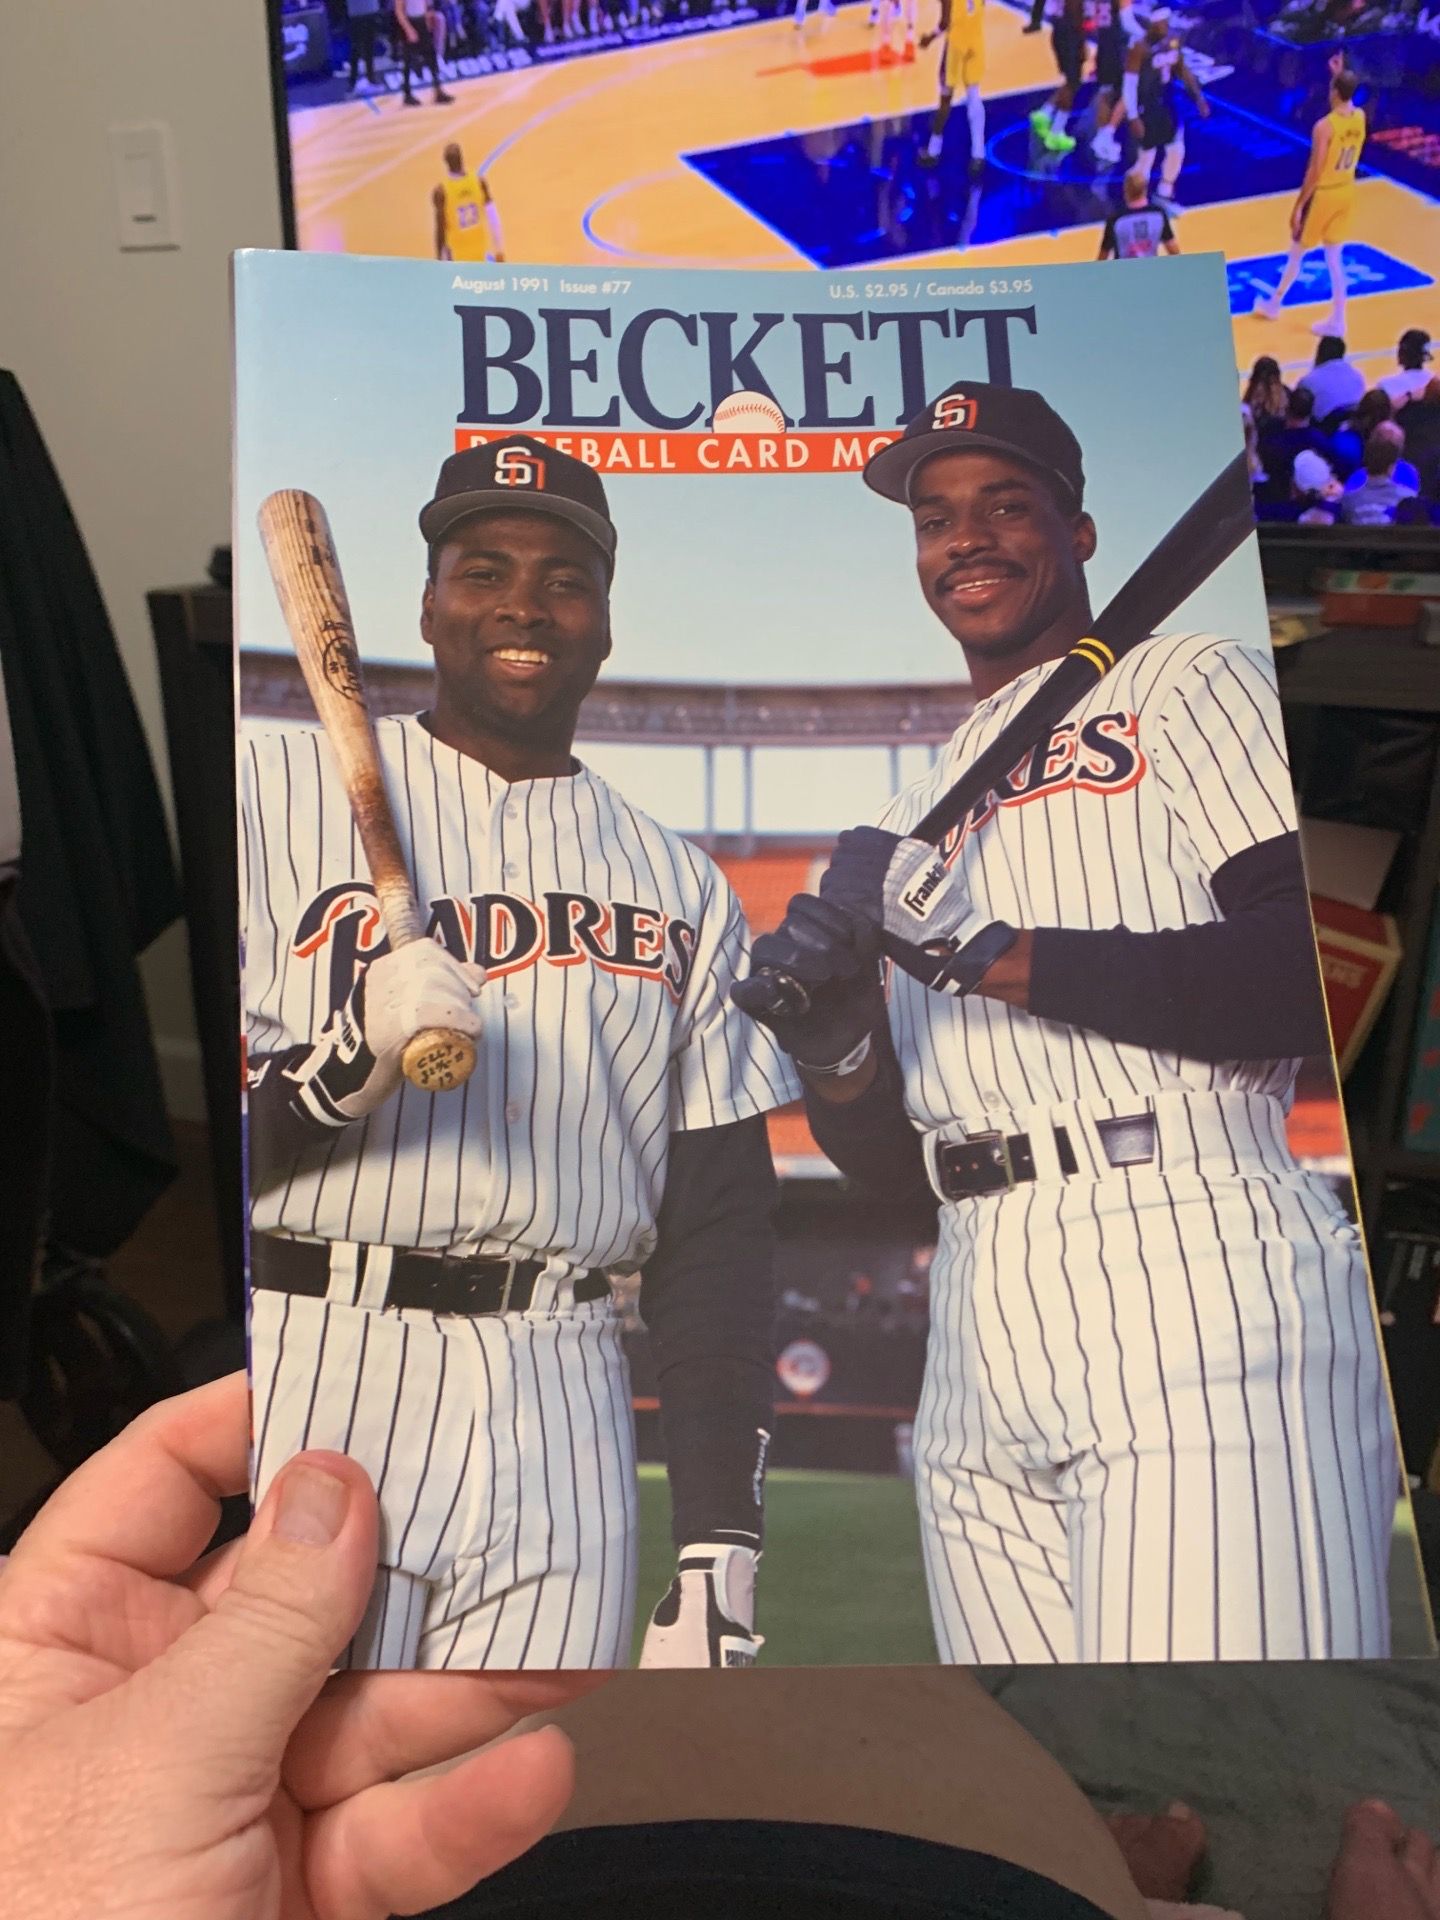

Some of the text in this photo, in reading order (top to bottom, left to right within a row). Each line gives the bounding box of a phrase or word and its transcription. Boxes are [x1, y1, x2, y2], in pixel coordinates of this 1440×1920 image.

[452, 276, 631, 294] August 1991 Issue #77
[829, 284, 860, 299] U.S.
[865, 283, 908, 298] $2.95
[926, 280, 984, 296] Canada
[989, 279, 1033, 294] $3.95
[453, 304, 1038, 432] BECKETT
[697, 436, 810, 470] CARD
